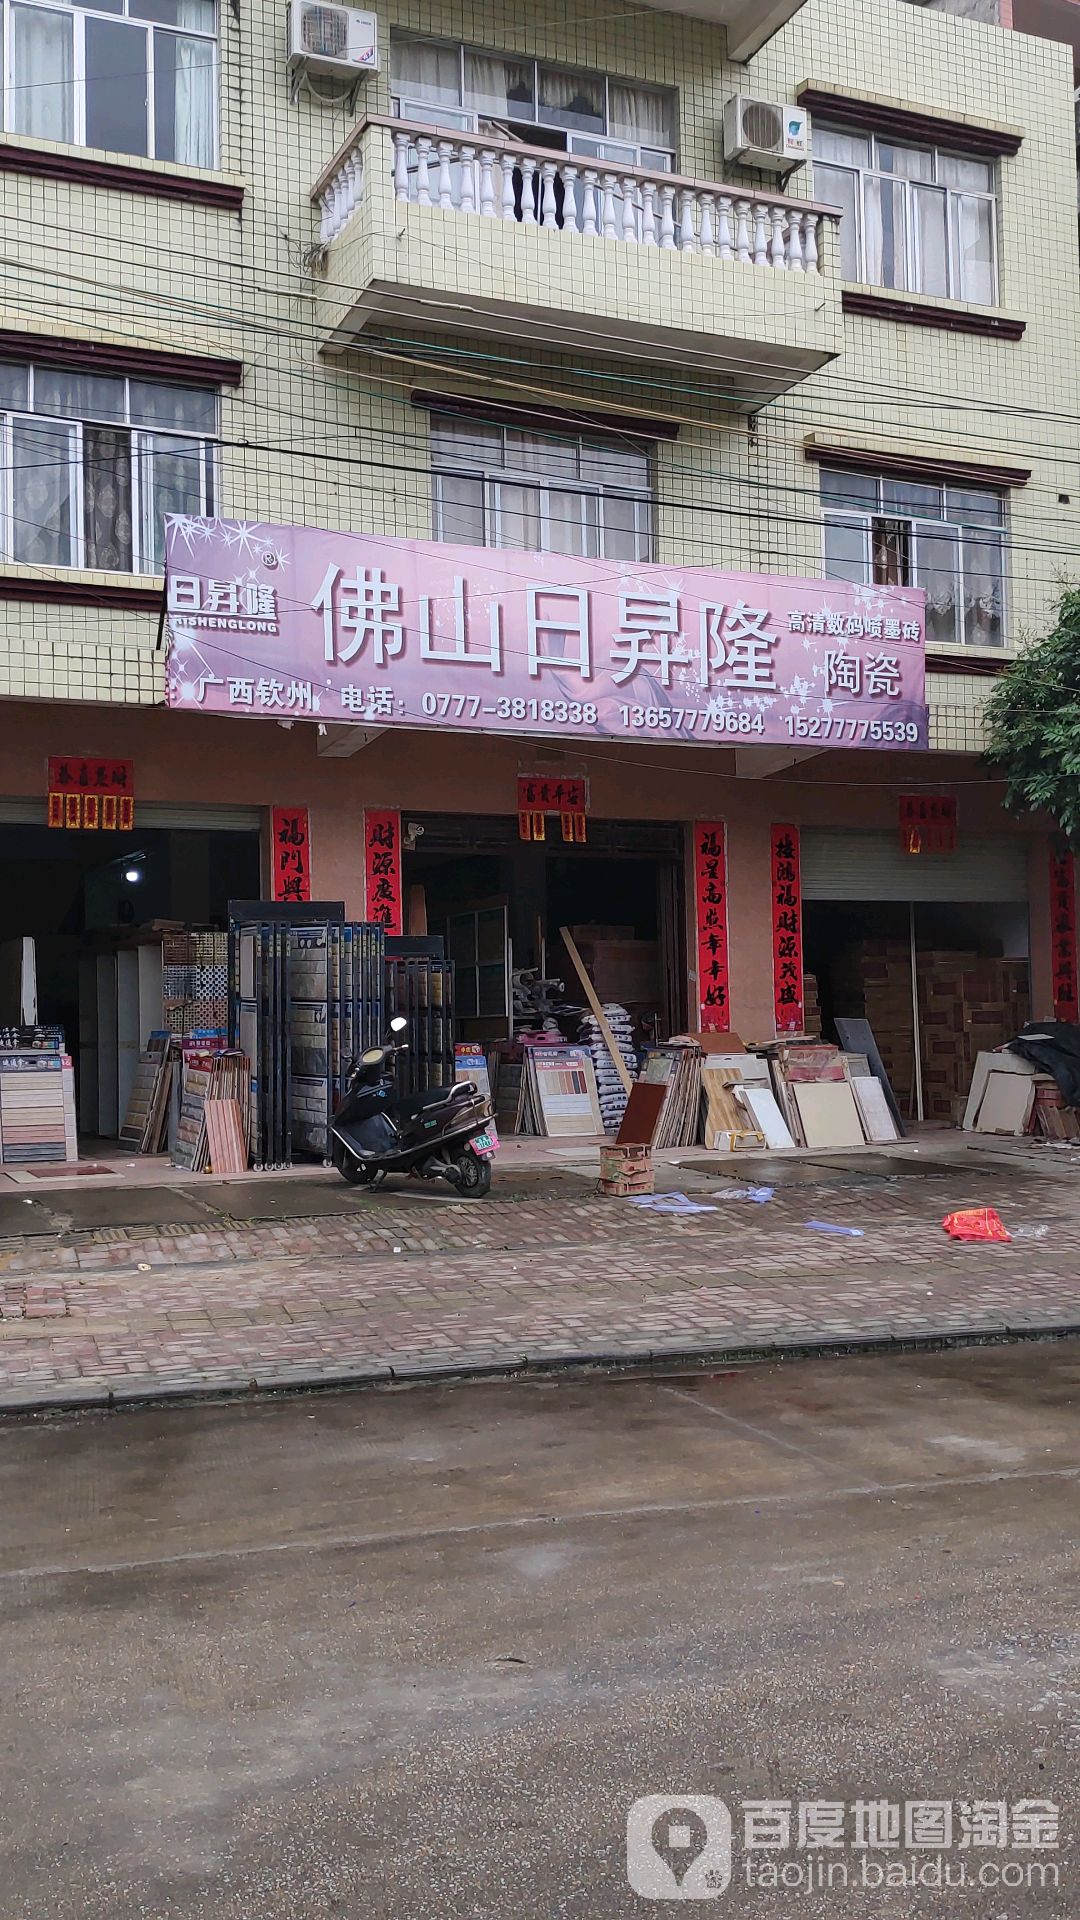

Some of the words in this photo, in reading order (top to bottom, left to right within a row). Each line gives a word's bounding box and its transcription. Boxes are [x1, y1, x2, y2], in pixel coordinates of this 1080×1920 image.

[167, 575, 277, 617] 日昇隆
[311, 562, 778, 691] 佛山日昇隆
[787, 609, 920, 641] 高清数码喷墨砖
[824, 648, 900, 697] 陶瓷
[196, 674, 314, 712] 广西钦州
[421, 692, 598, 725] 0777-3818338
[619, 704, 766, 735] 13657779684
[784, 716, 919, 743] 15277775539
